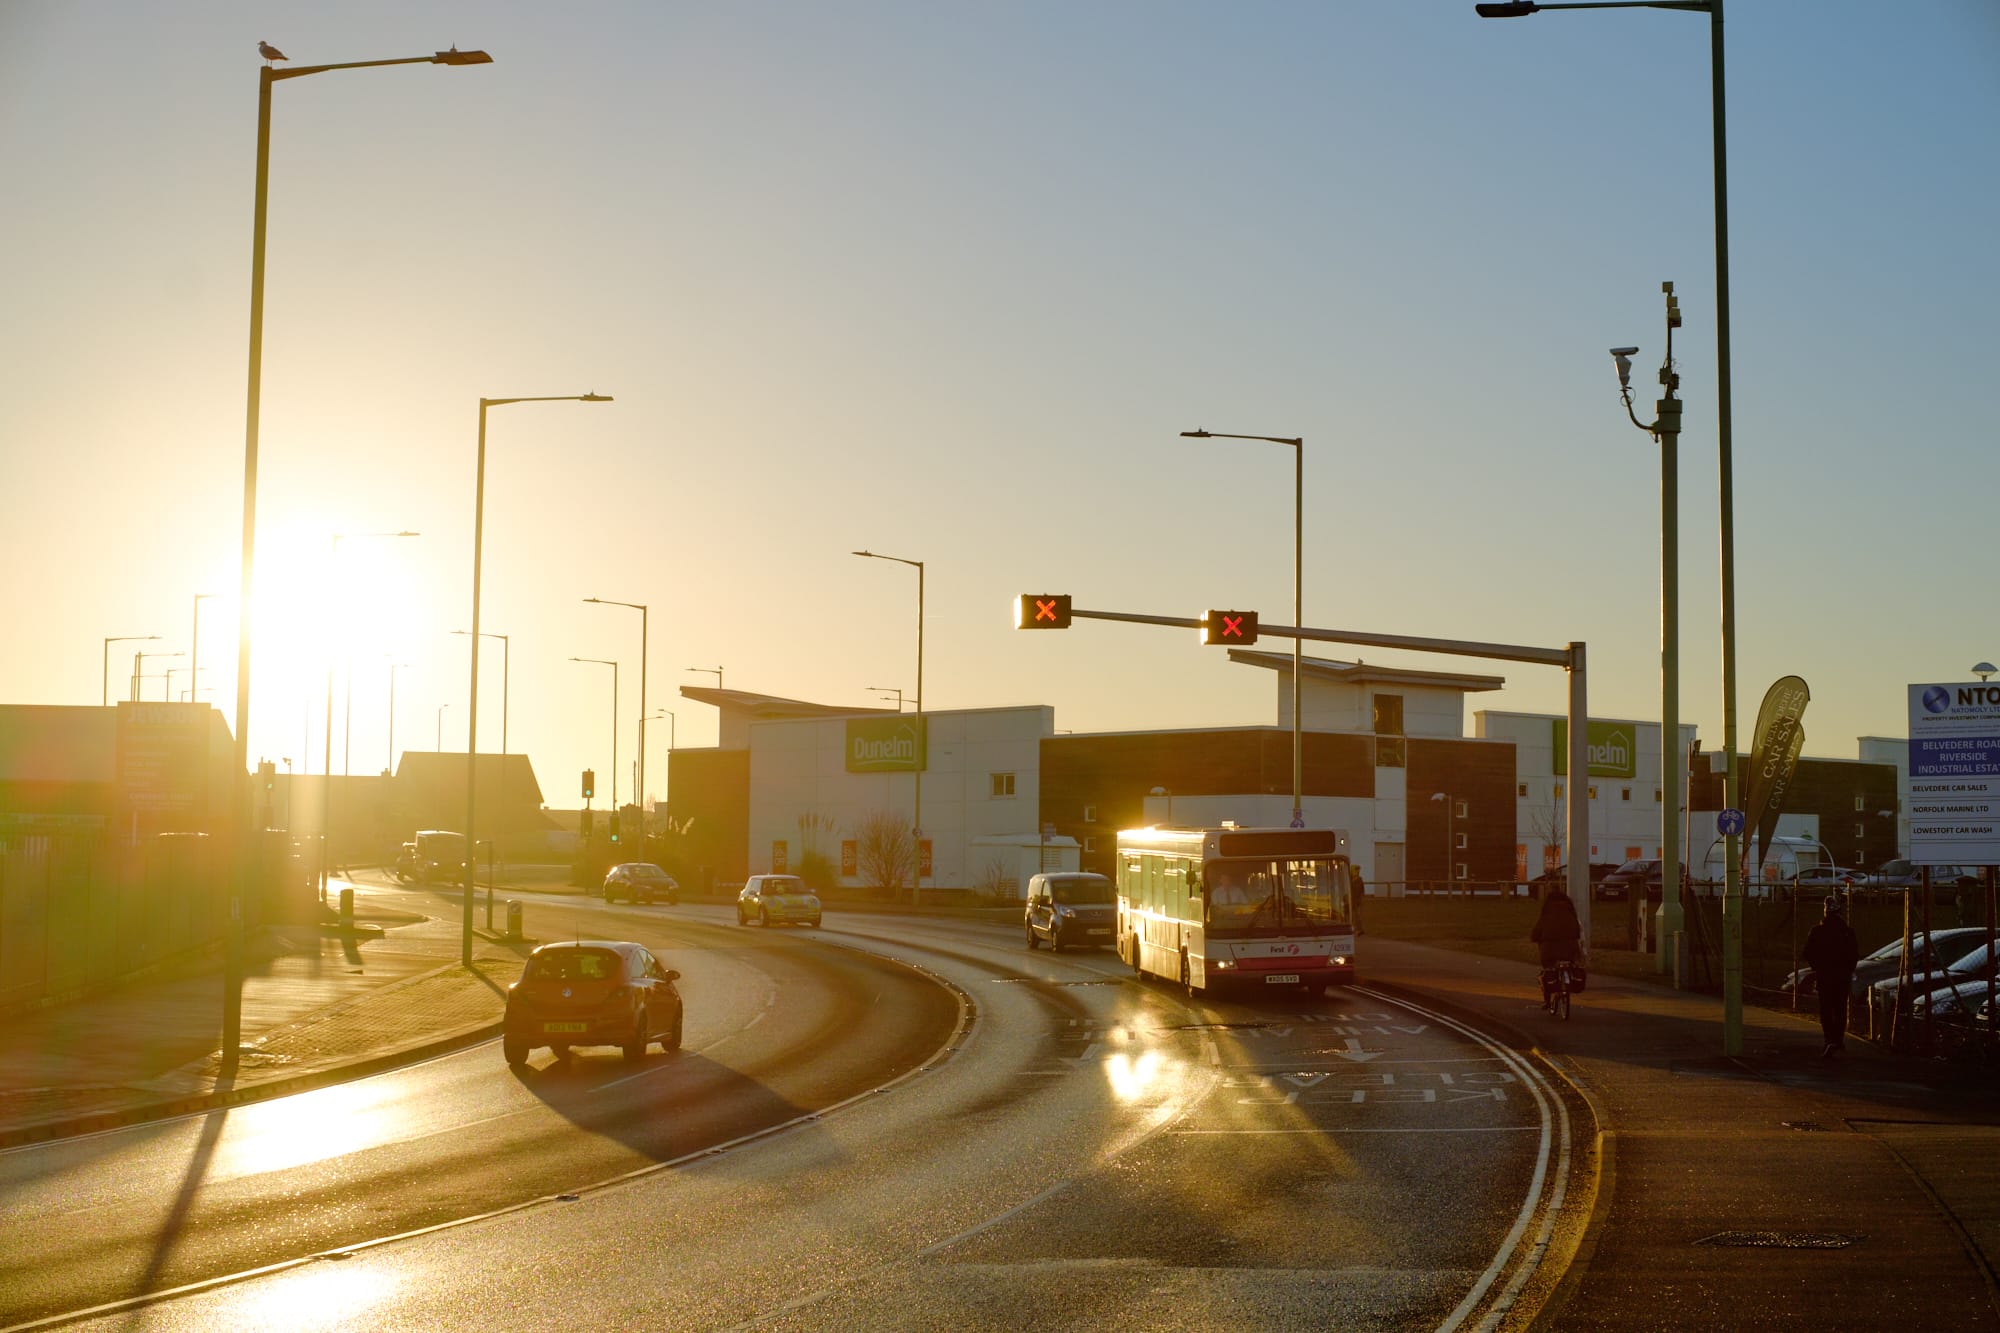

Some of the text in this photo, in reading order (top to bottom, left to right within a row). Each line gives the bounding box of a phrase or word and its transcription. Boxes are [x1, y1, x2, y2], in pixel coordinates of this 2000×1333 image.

[1763, 690, 1805, 778] CAR SALES
[855, 736, 913, 759] Dunelm
[1587, 740, 1626, 764] nelm
[1922, 740, 1974, 750] BELVEDERE
[1940, 752, 1987, 762] RIVERSIDE
[1918, 764, 1974, 774] INDUSTRIAL
[1769, 779, 1786, 809] CAR
[1270, 945, 1285, 953] First
[1221, 1072, 1515, 1088] CLEAR
[1237, 1088, 1507, 1105] KEEP
